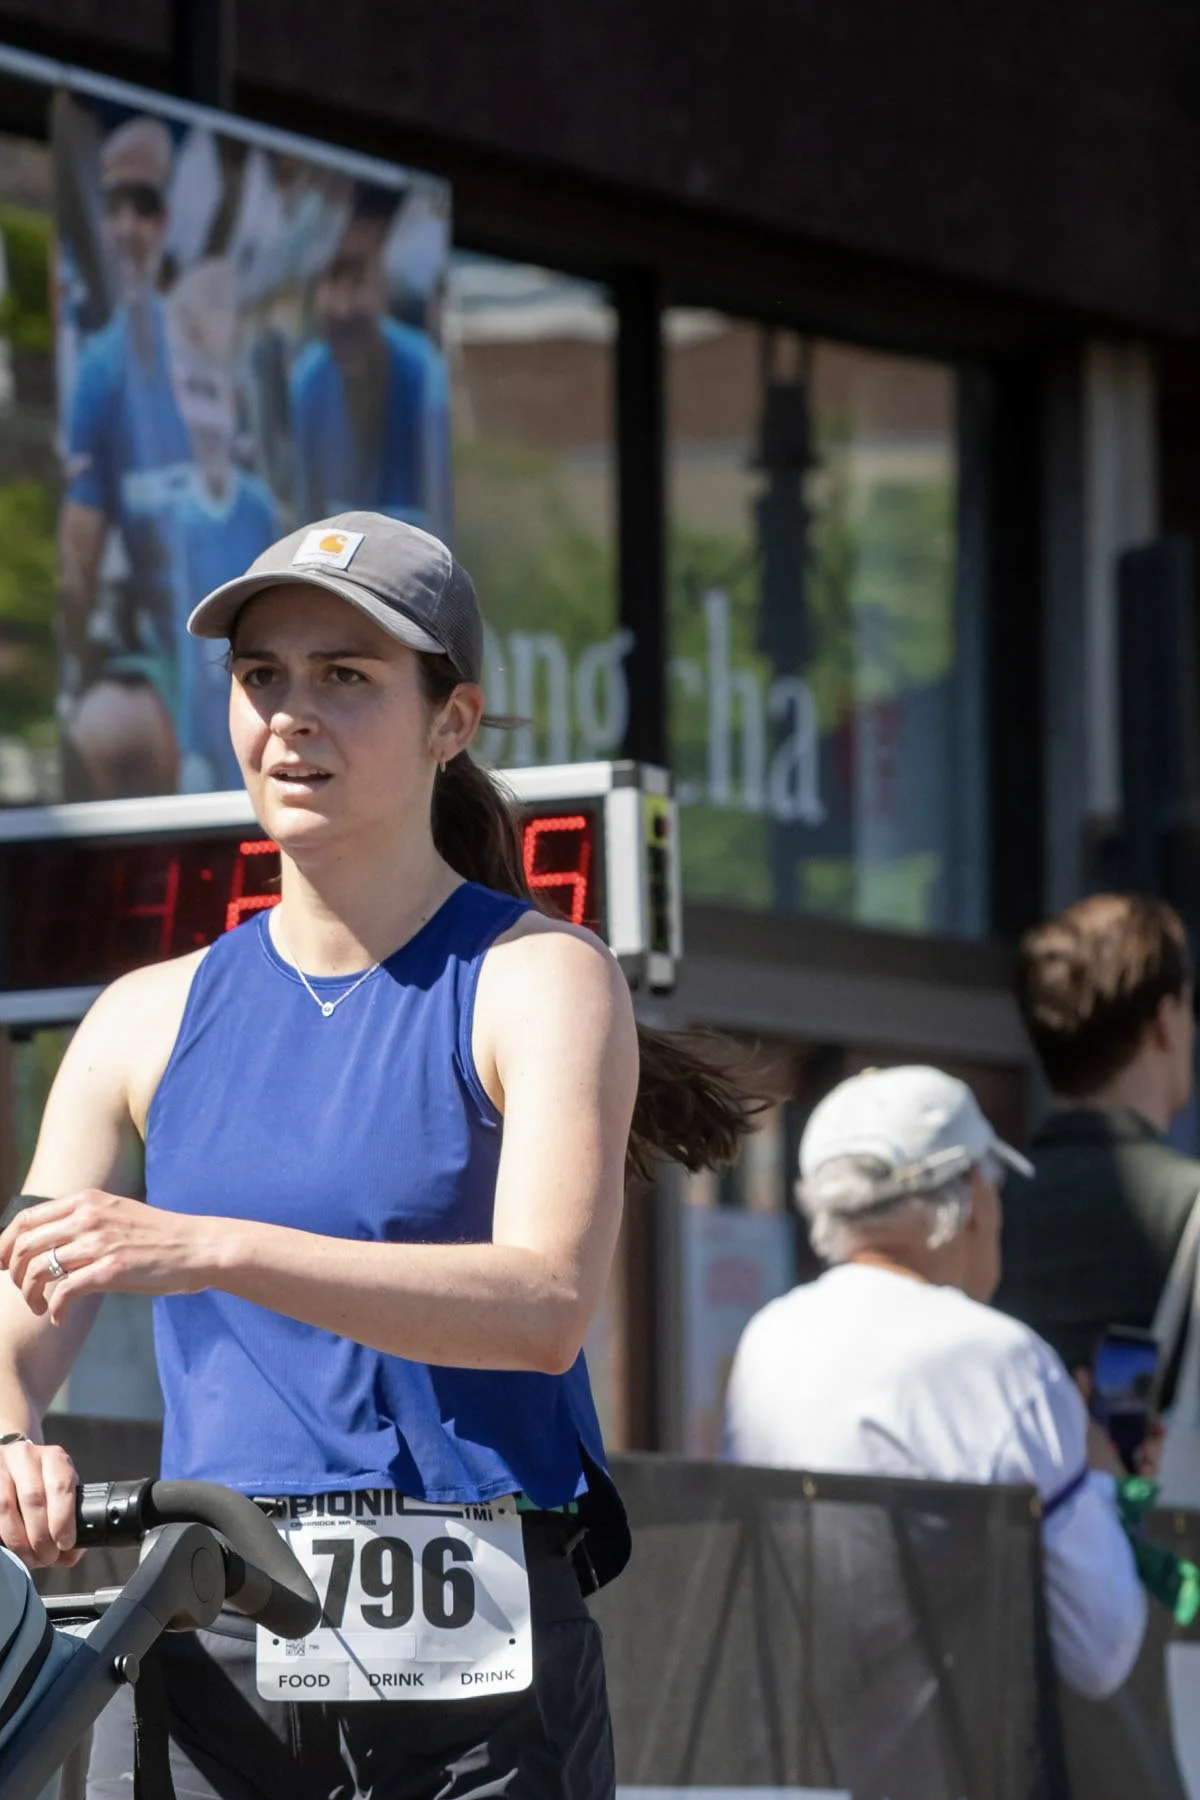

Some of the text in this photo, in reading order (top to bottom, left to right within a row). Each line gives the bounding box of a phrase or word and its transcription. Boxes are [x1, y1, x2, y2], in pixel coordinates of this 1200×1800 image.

[312, 1536, 475, 1630] 796
[278, 1669, 516, 1688] FOOD DRINK DRINK
